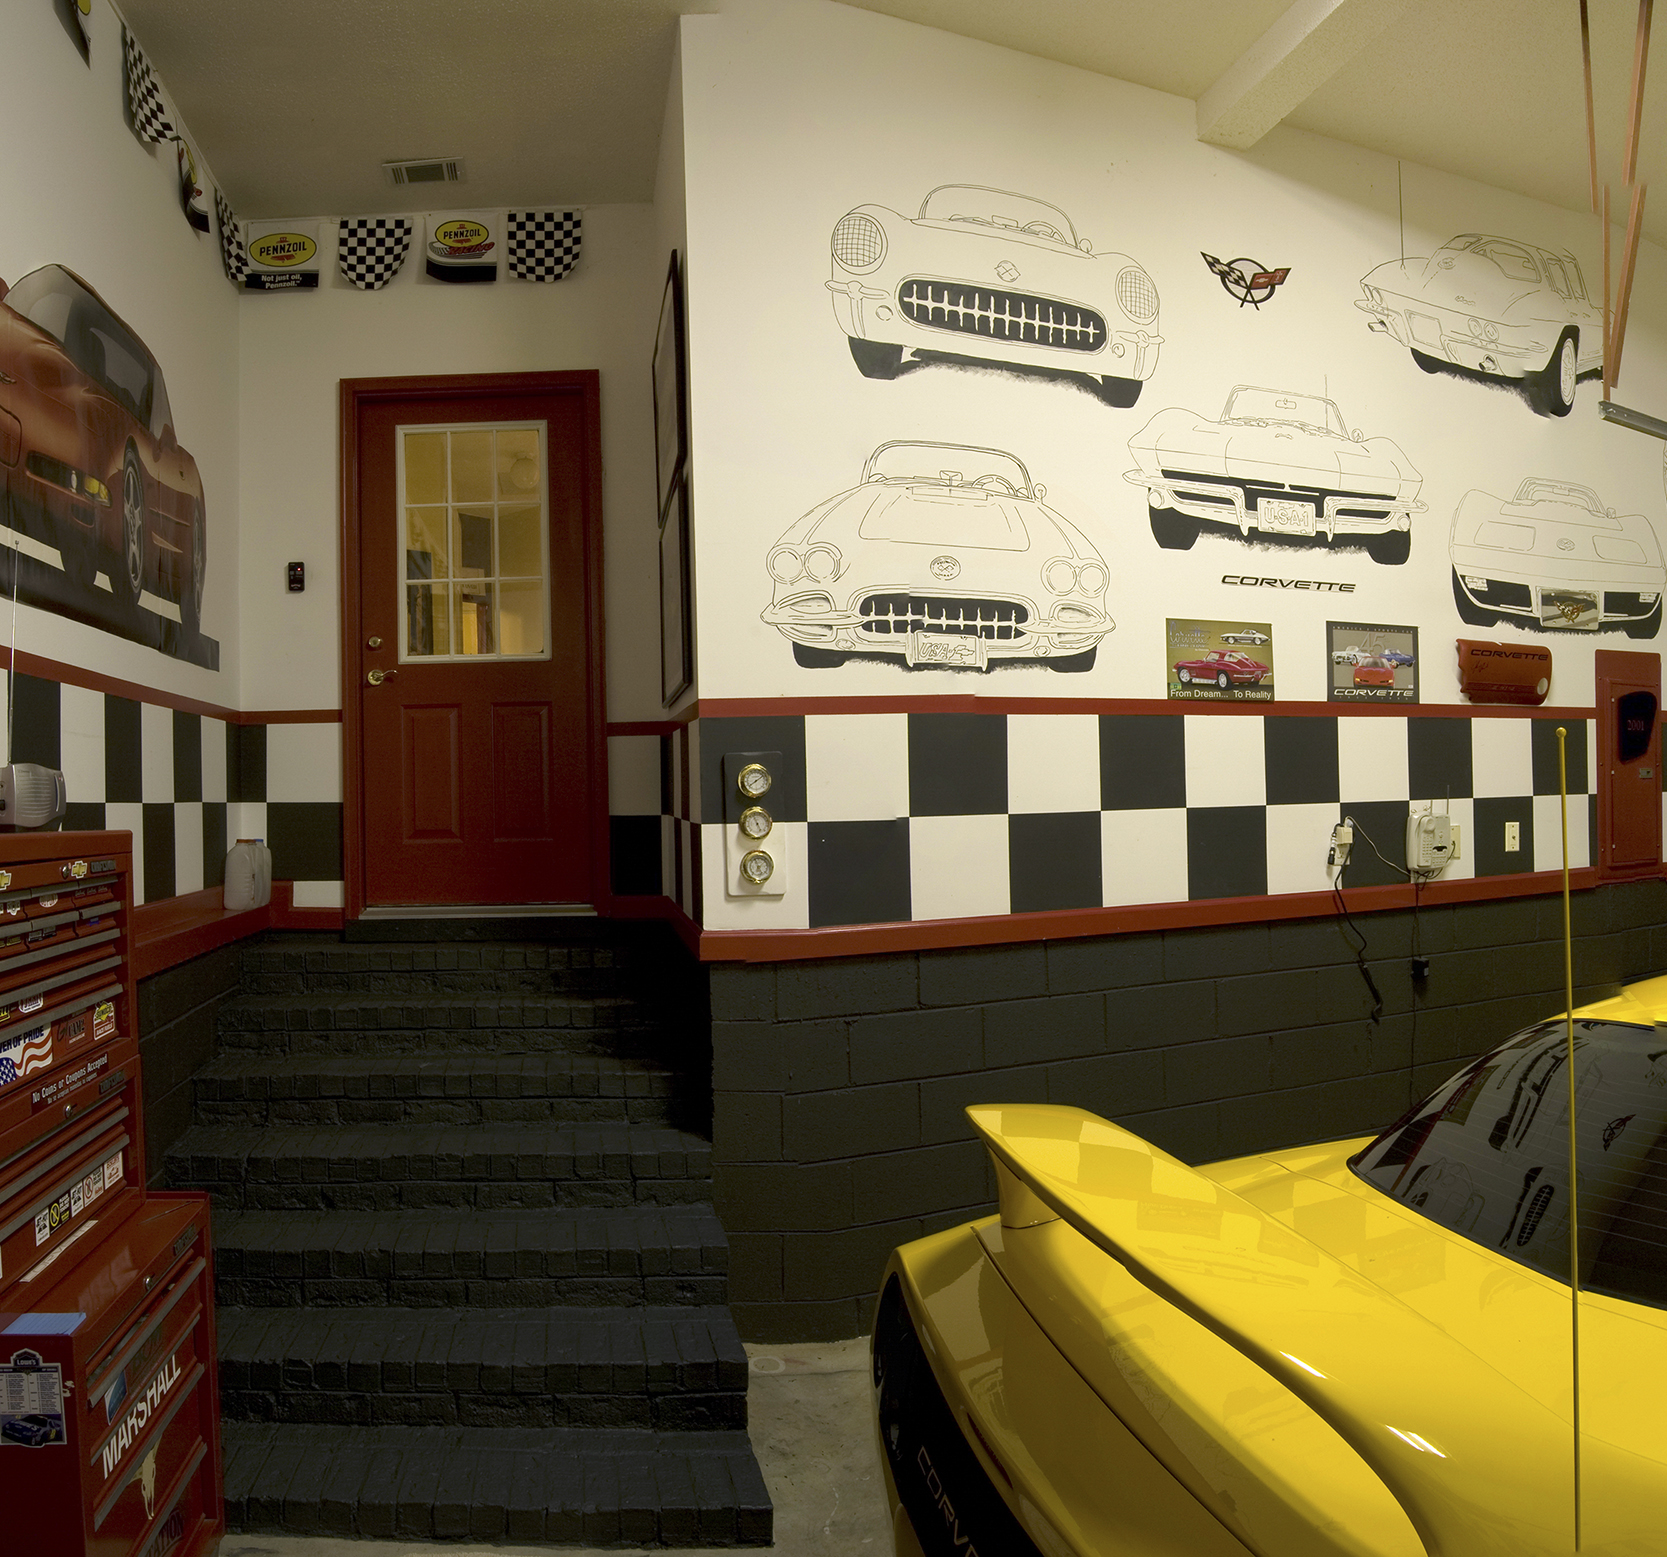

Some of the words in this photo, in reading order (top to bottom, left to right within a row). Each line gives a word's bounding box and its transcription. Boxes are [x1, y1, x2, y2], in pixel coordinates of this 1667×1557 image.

[443, 228, 482, 240] PENNZOIL
[259, 239, 308, 257] PENNZOIL
[261, 274, 273, 282] Not
[275, 273, 286, 283] just
[1221, 574, 1356, 593] CORVETTE
[919, 641, 950, 661] USA
[1360, 632, 1386, 655] 45
[1470, 648, 1549, 661] CORVETTE
[1170, 689, 1192, 699] From
[1194, 689, 1230, 699] Dream...
[1233, 690, 1243, 699] To
[1245, 690, 1272, 701] Reality
[1334, 688, 1414, 699] CORVETTE
[1627, 719, 1645, 732] 2001
[13, 1034, 22, 1048] OF
[23, 1025, 45, 1045] PRIDE
[32, 1091, 41, 1104] No
[41, 1082, 57, 1099] Coins
[58, 1078, 64, 1090] or
[65, 1066, 87, 1085] Coupons
[87, 1053, 108, 1074] Accepted
[103, 1354, 181, 1479] MARSHALL
